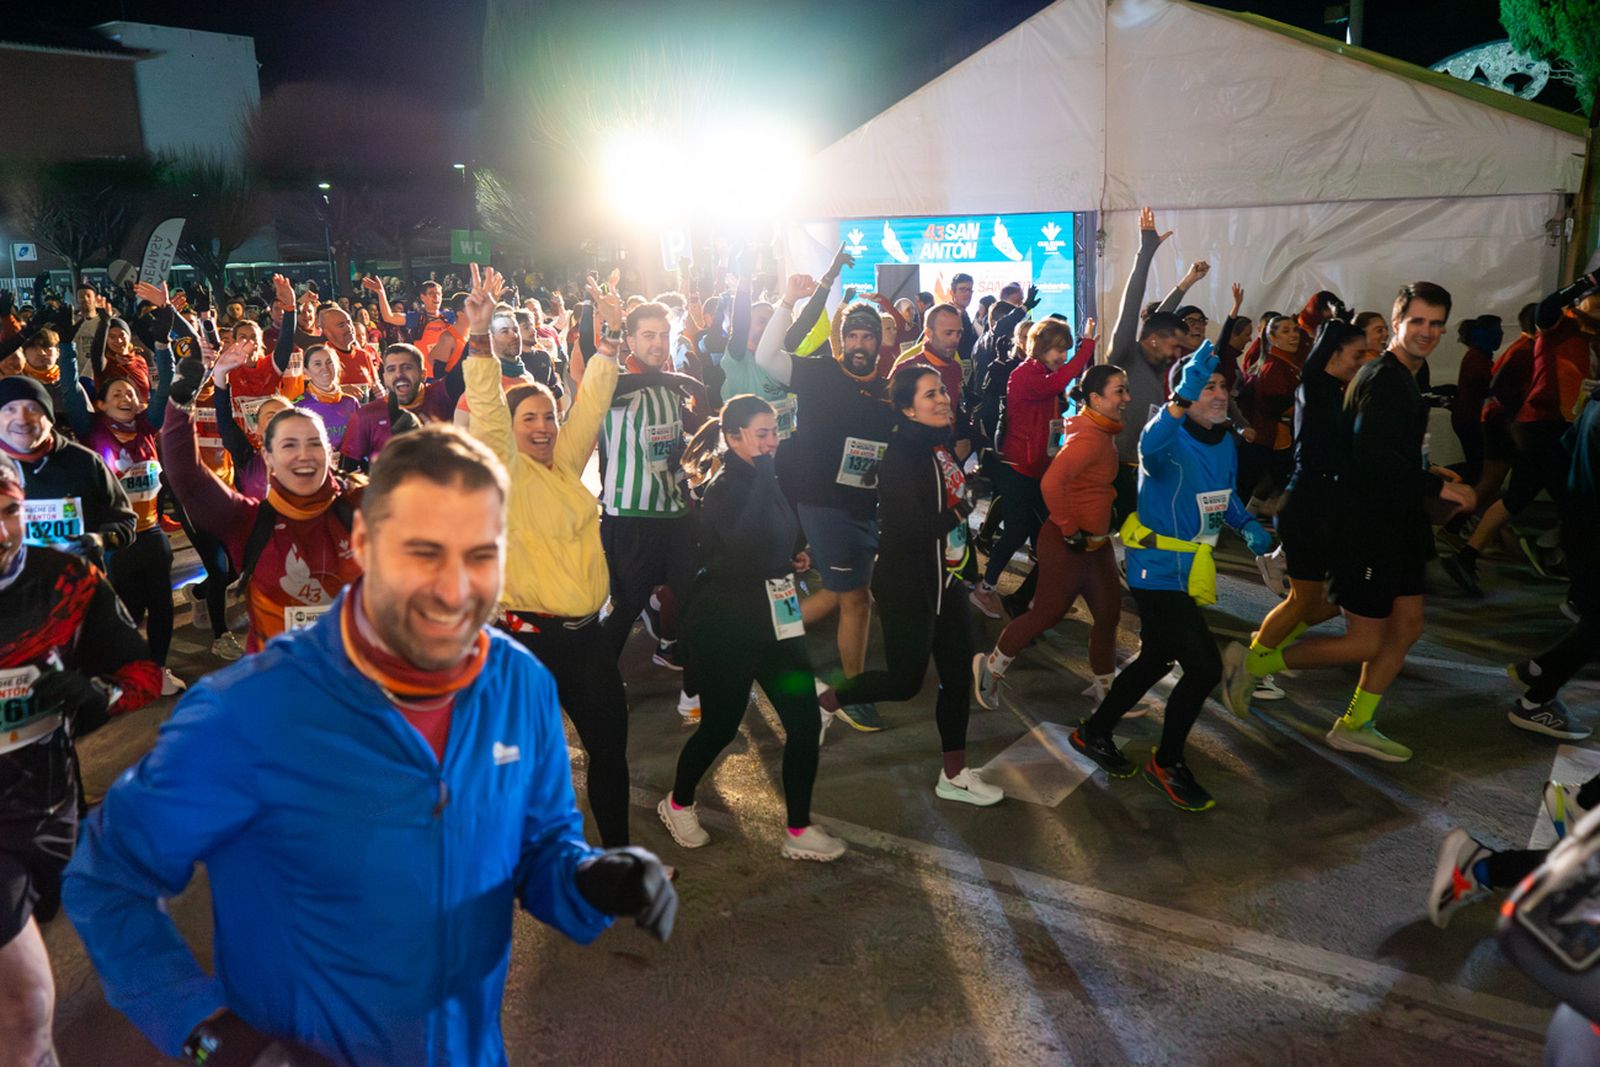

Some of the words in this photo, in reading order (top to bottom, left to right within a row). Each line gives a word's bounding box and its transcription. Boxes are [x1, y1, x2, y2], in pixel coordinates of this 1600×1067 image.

[923, 223, 945, 241] 43
[944, 223, 980, 241] SAN
[460, 240, 482, 255] WC
[919, 238, 978, 260] ANTÓN
[127, 474, 154, 489] 8441
[299, 583, 321, 603] 43
